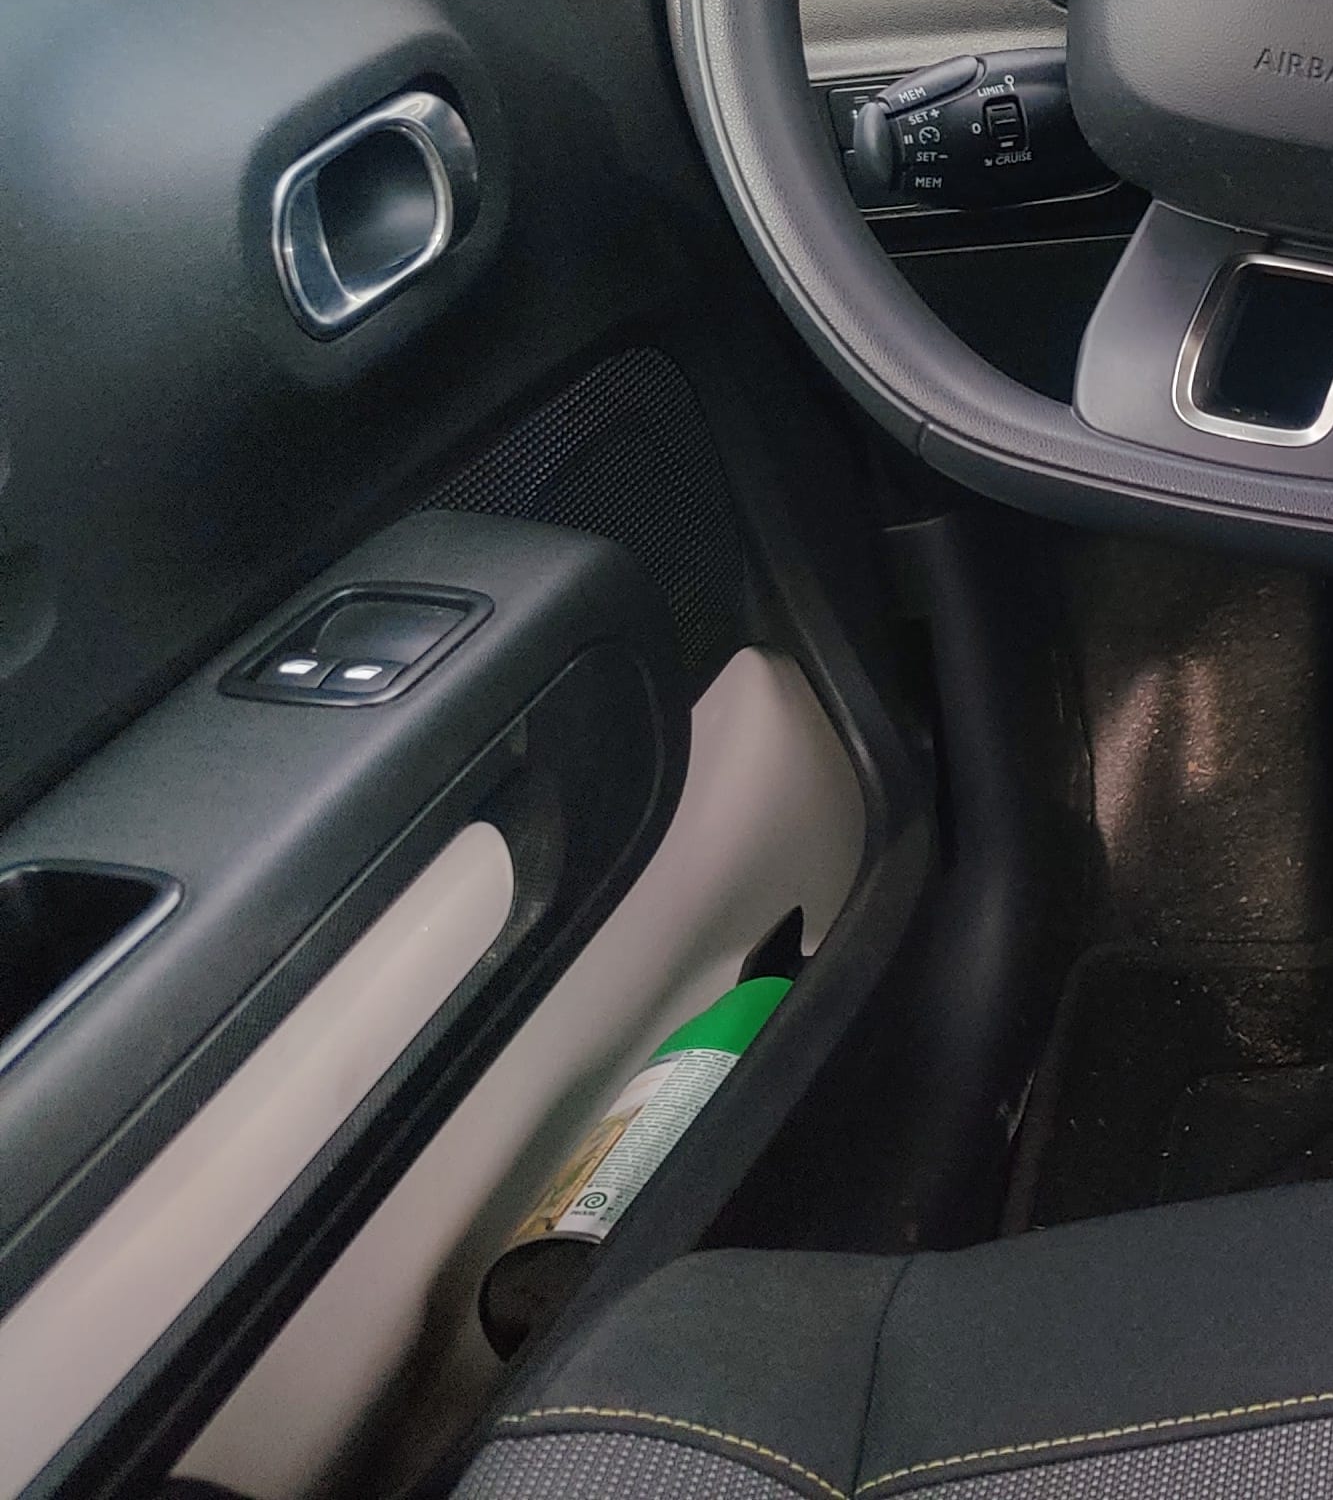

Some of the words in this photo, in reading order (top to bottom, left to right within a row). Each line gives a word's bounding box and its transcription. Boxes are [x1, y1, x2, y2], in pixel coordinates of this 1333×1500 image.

[898, 87, 927, 103] MEM
[976, 84, 1005, 98] LIMIT
[971, 123, 982, 135] 0
[995, 151, 1033, 166] CRUISE
[915, 177, 943, 188] MEM
